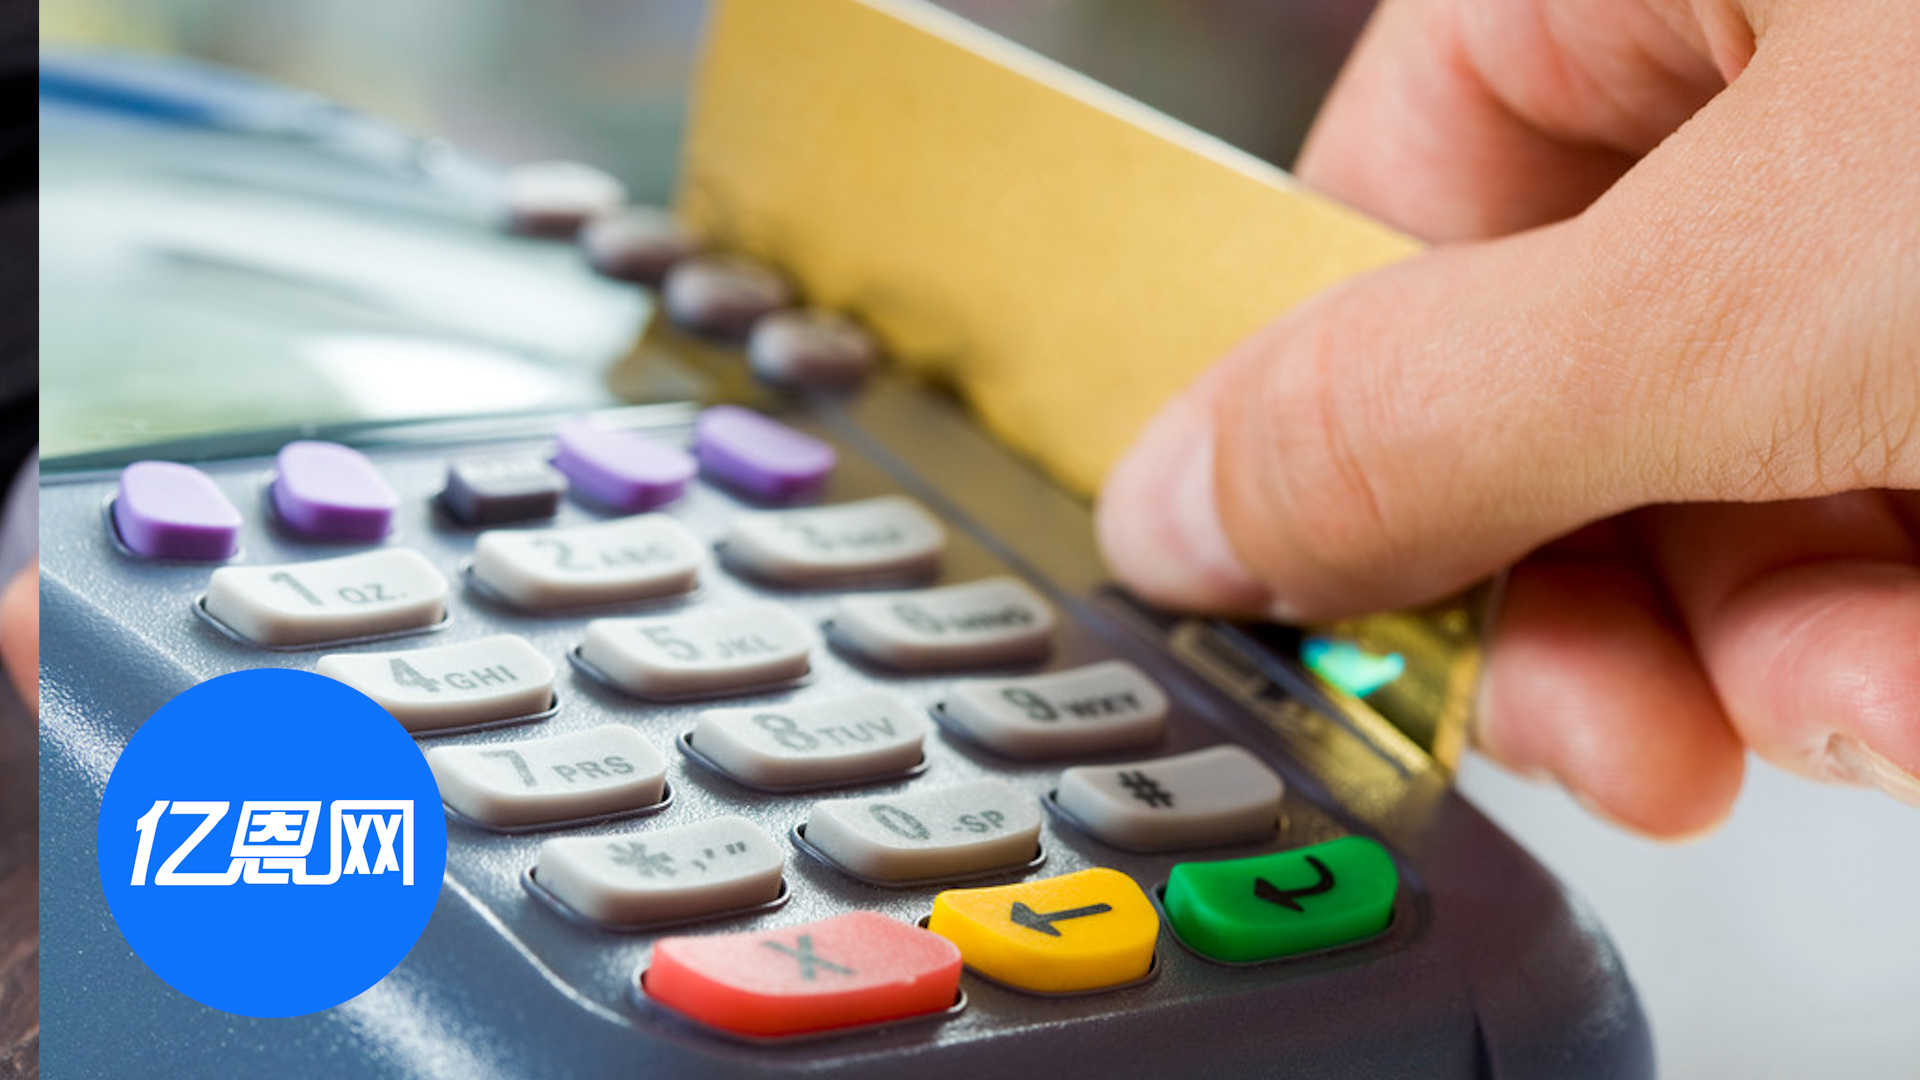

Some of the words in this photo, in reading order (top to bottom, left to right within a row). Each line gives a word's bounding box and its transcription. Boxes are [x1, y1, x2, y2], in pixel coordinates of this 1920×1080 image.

[531, 538, 595, 572] 2
[269, 571, 325, 606] 1
[636, 625, 701, 661] 5
[388, 657, 441, 694] 4
[443, 665, 517, 691] GHI
[1002, 687, 1060, 722] 9
[753, 713, 818, 752] 8
[818, 717, 898, 748] TUV
[480, 748, 537, 788] 7
[553, 756, 636, 785] PRS
